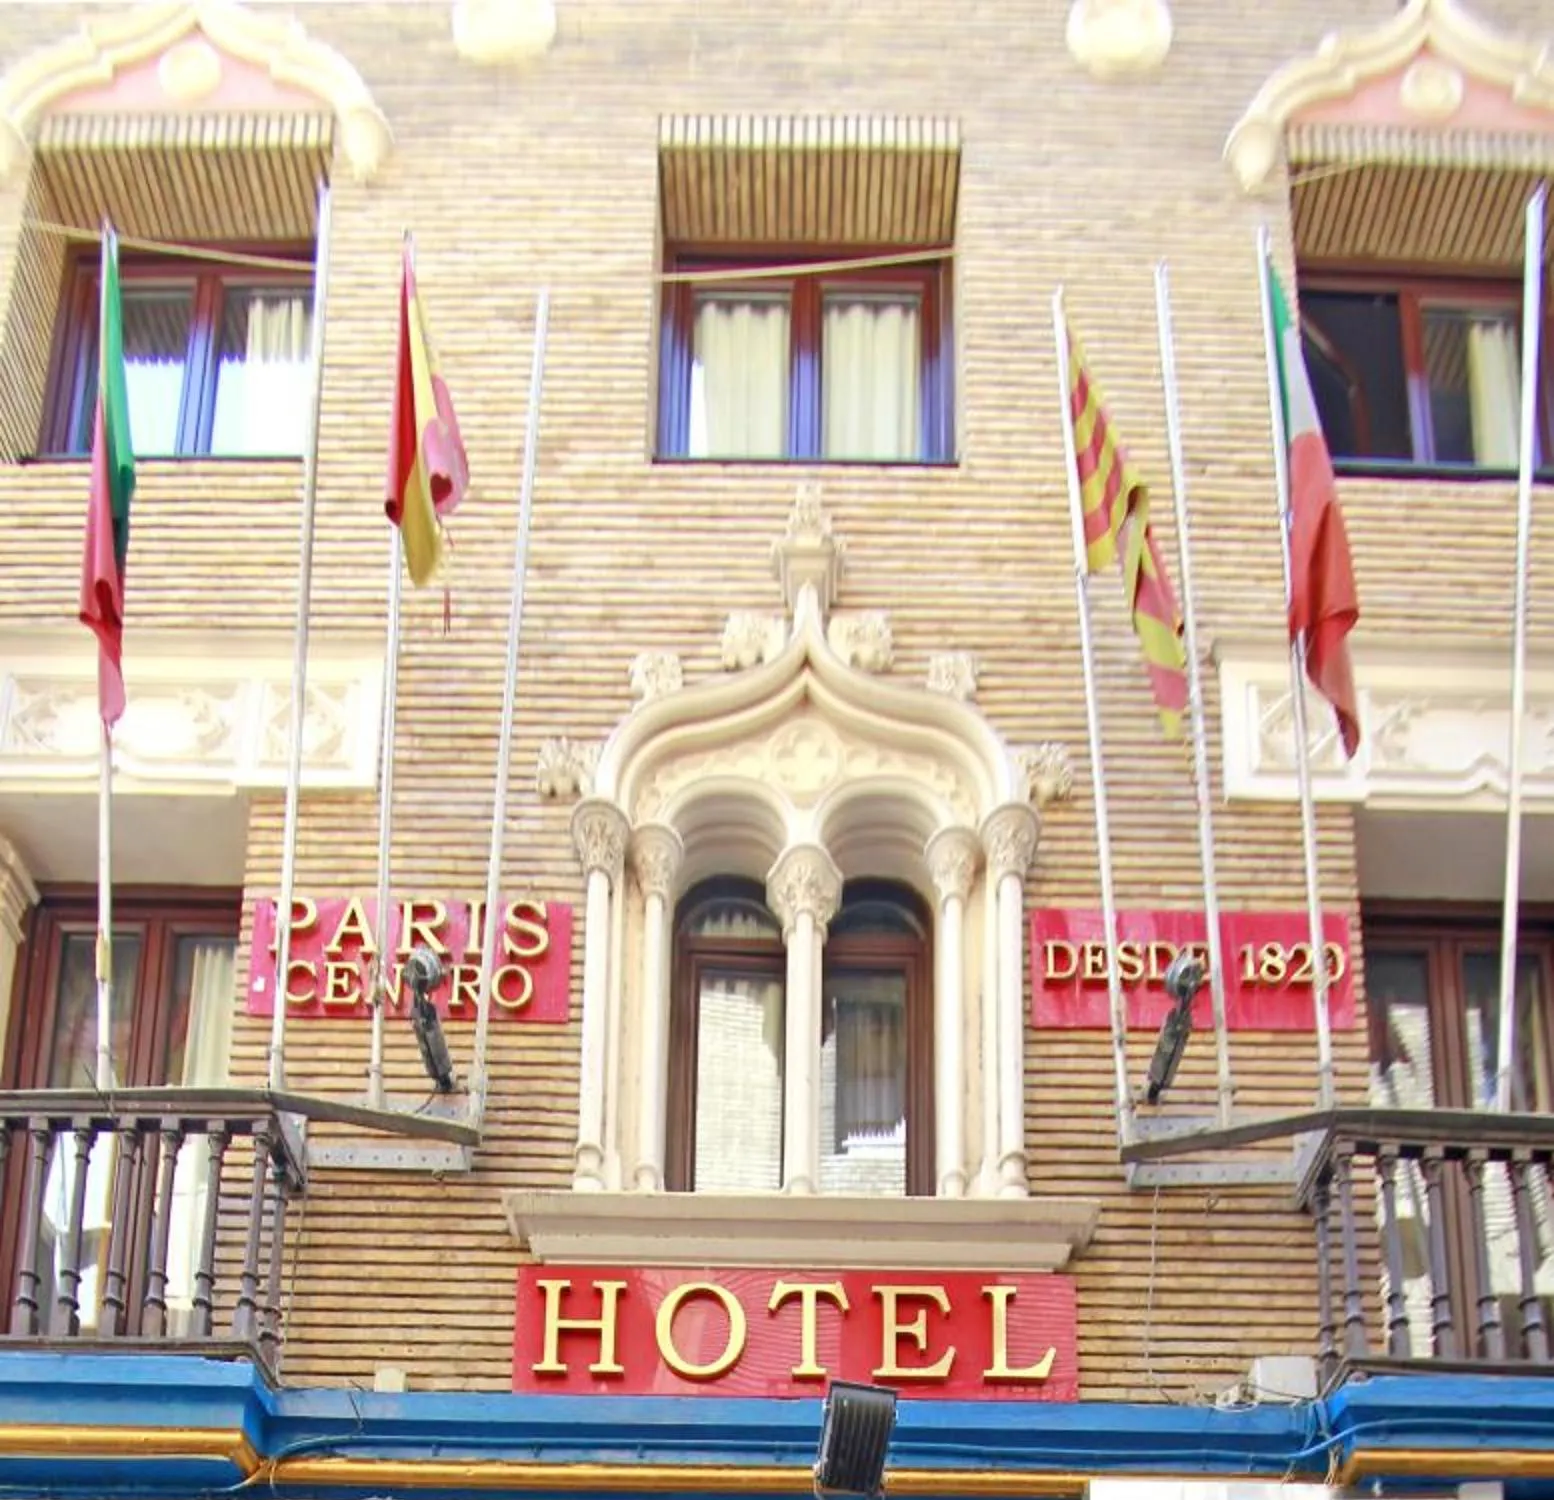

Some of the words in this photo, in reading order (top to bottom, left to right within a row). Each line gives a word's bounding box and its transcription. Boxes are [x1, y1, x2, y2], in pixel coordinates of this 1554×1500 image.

[268, 897, 549, 957] PARIS
[284, 959, 534, 1009] CENRO
[1043, 939, 1212, 982] DESDE
[1240, 941, 1345, 983] 1820
[531, 1279, 1057, 1380] HOTEL
